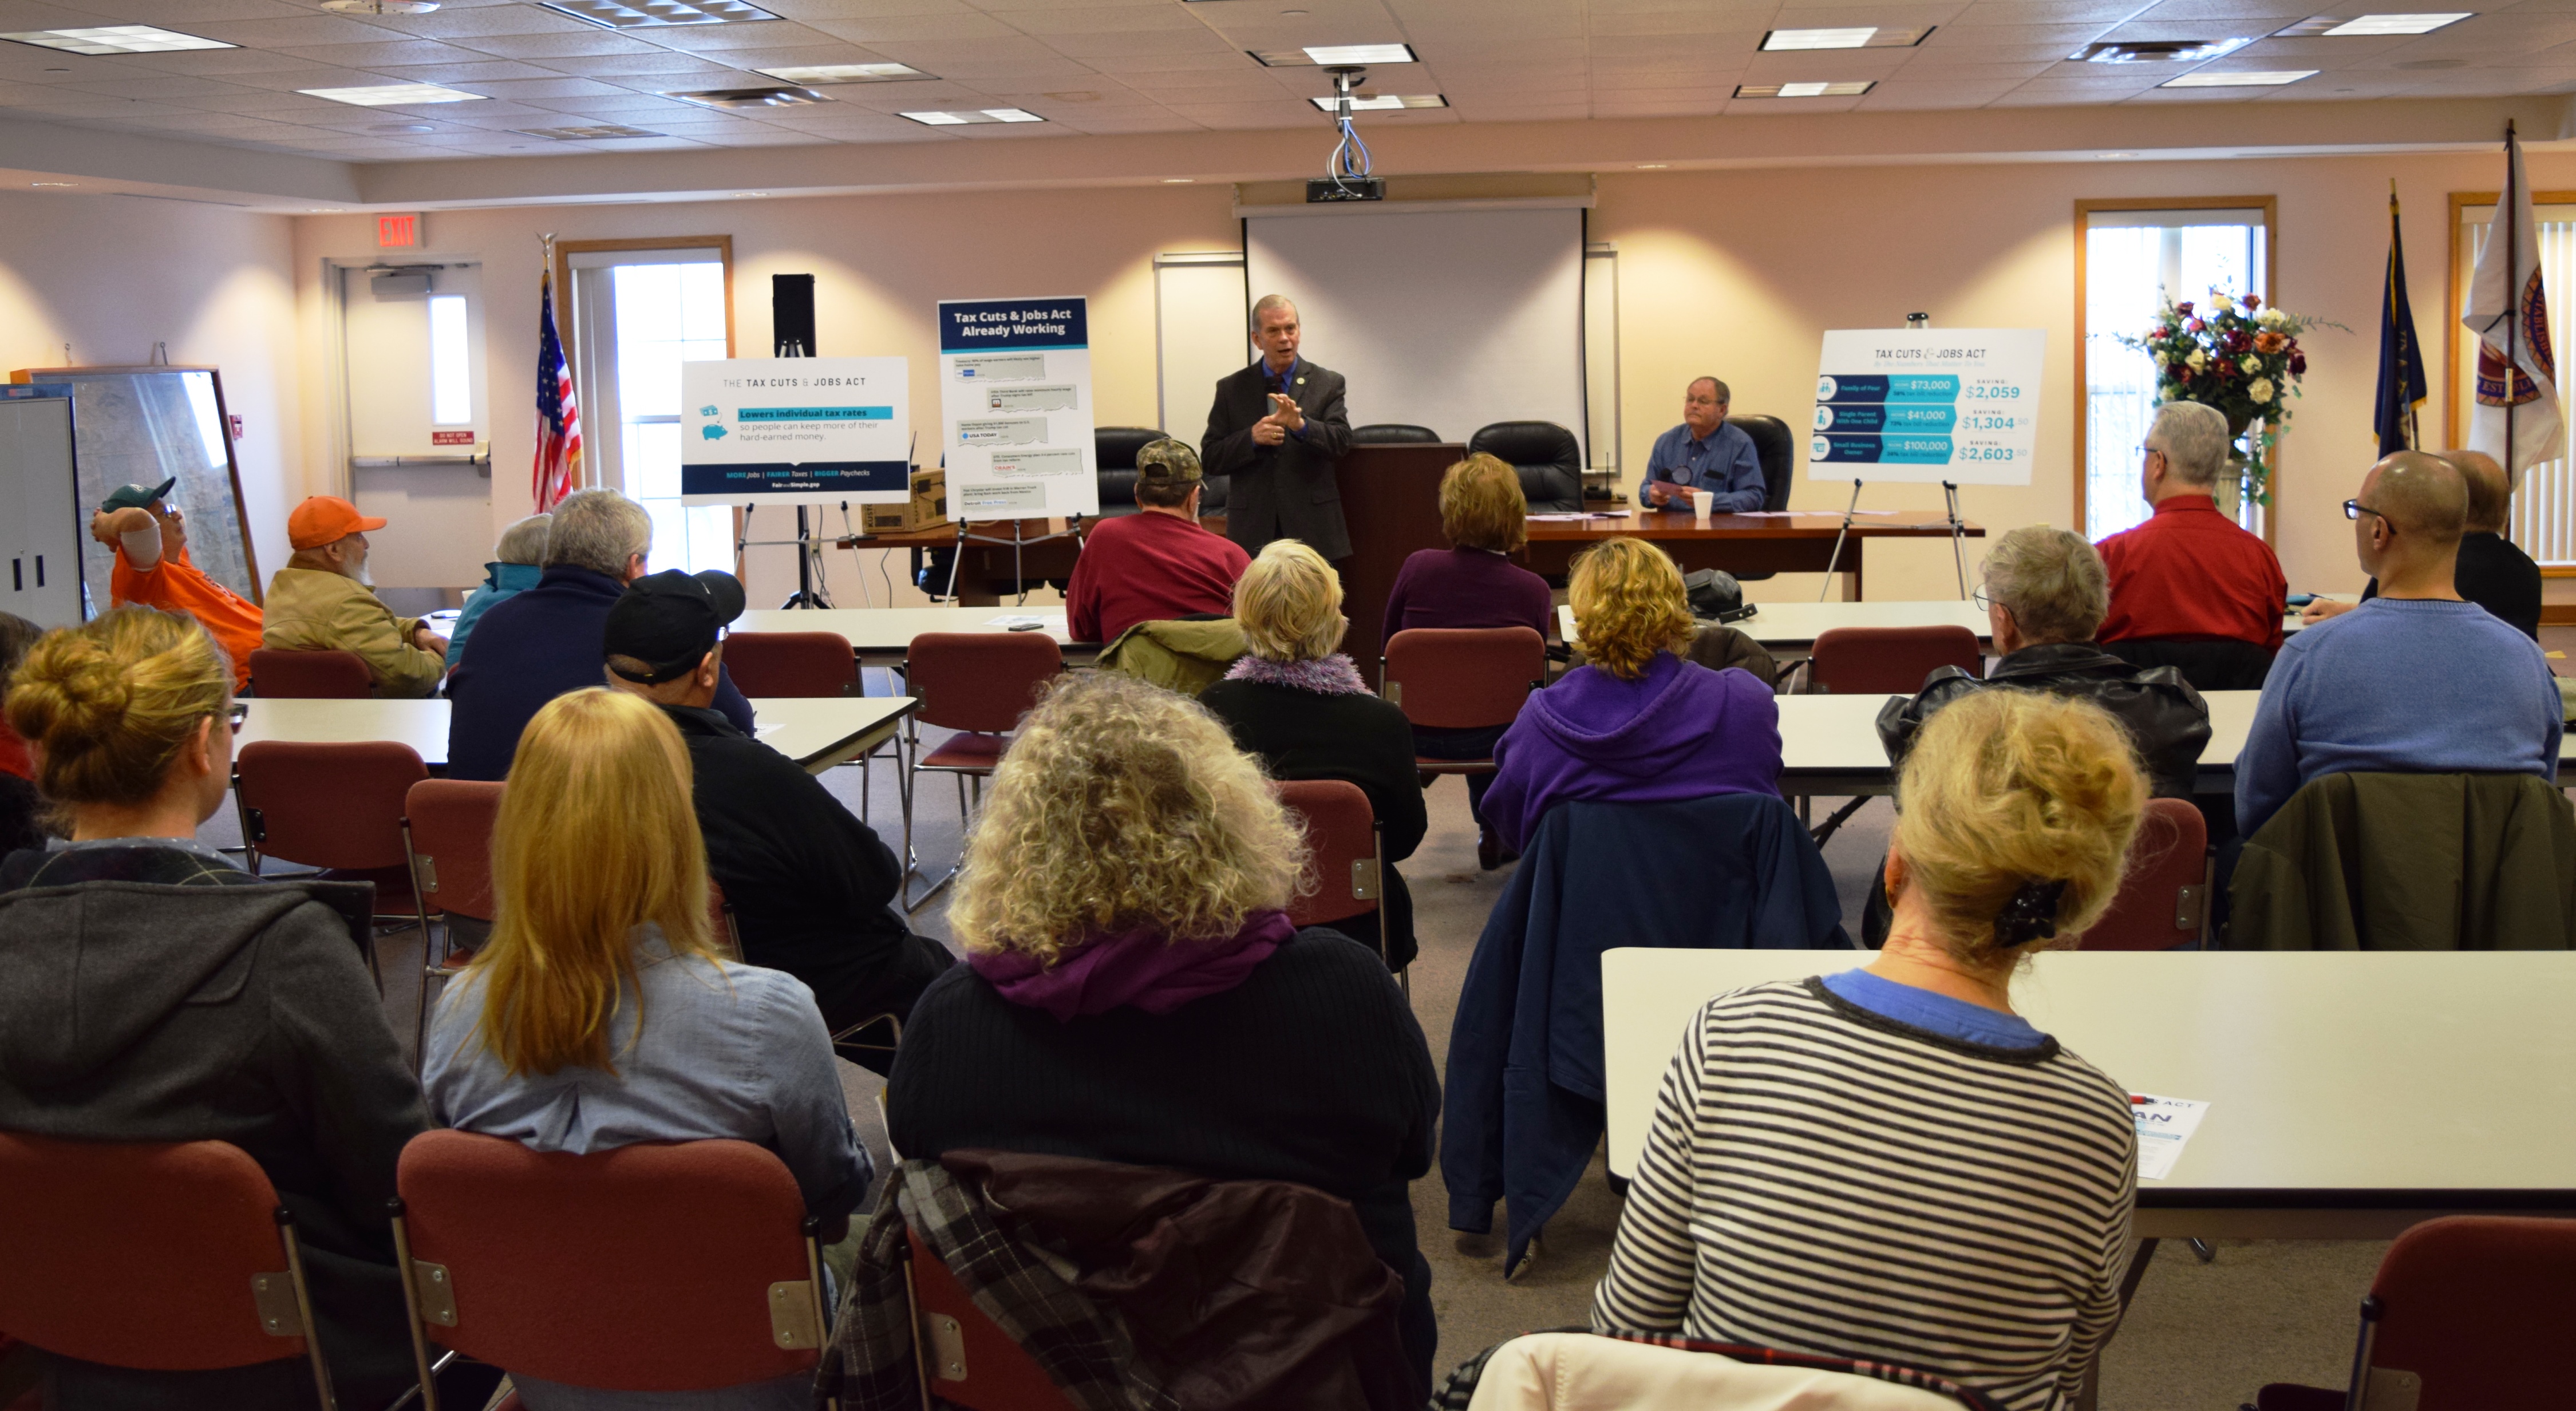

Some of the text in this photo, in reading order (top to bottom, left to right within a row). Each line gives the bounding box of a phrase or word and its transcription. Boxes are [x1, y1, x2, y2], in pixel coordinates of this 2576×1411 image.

[379, 216, 414, 247] EXIT
[954, 310, 1071, 323] Tax Cuts & Jobs Act
[962, 323, 1065, 338] Already Working
[1875, 348, 1986, 359] TAX CUTS & JOBS ACT
[747, 379, 765, 387] TAX
[771, 378, 798, 386] CUTS
[803, 378, 809, 386] &
[814, 378, 841, 386] JOBS
[1911, 381, 1950, 390] $73,000
[1965, 386, 2020, 400] $2,059
[740, 410, 774, 418] Lowers
[776, 409, 823, 418] individual
[1907, 411, 1945, 420] $41,000
[753, 422, 781, 432] people
[801, 421, 821, 431] keep
[859, 421, 878, 429] their
[740, 432, 826, 442] hard-earned money.
[1904, 441, 1947, 450] $100,000
[840, 469, 870, 477] Paychecks
[2133, 1112, 2172, 1122] AN
